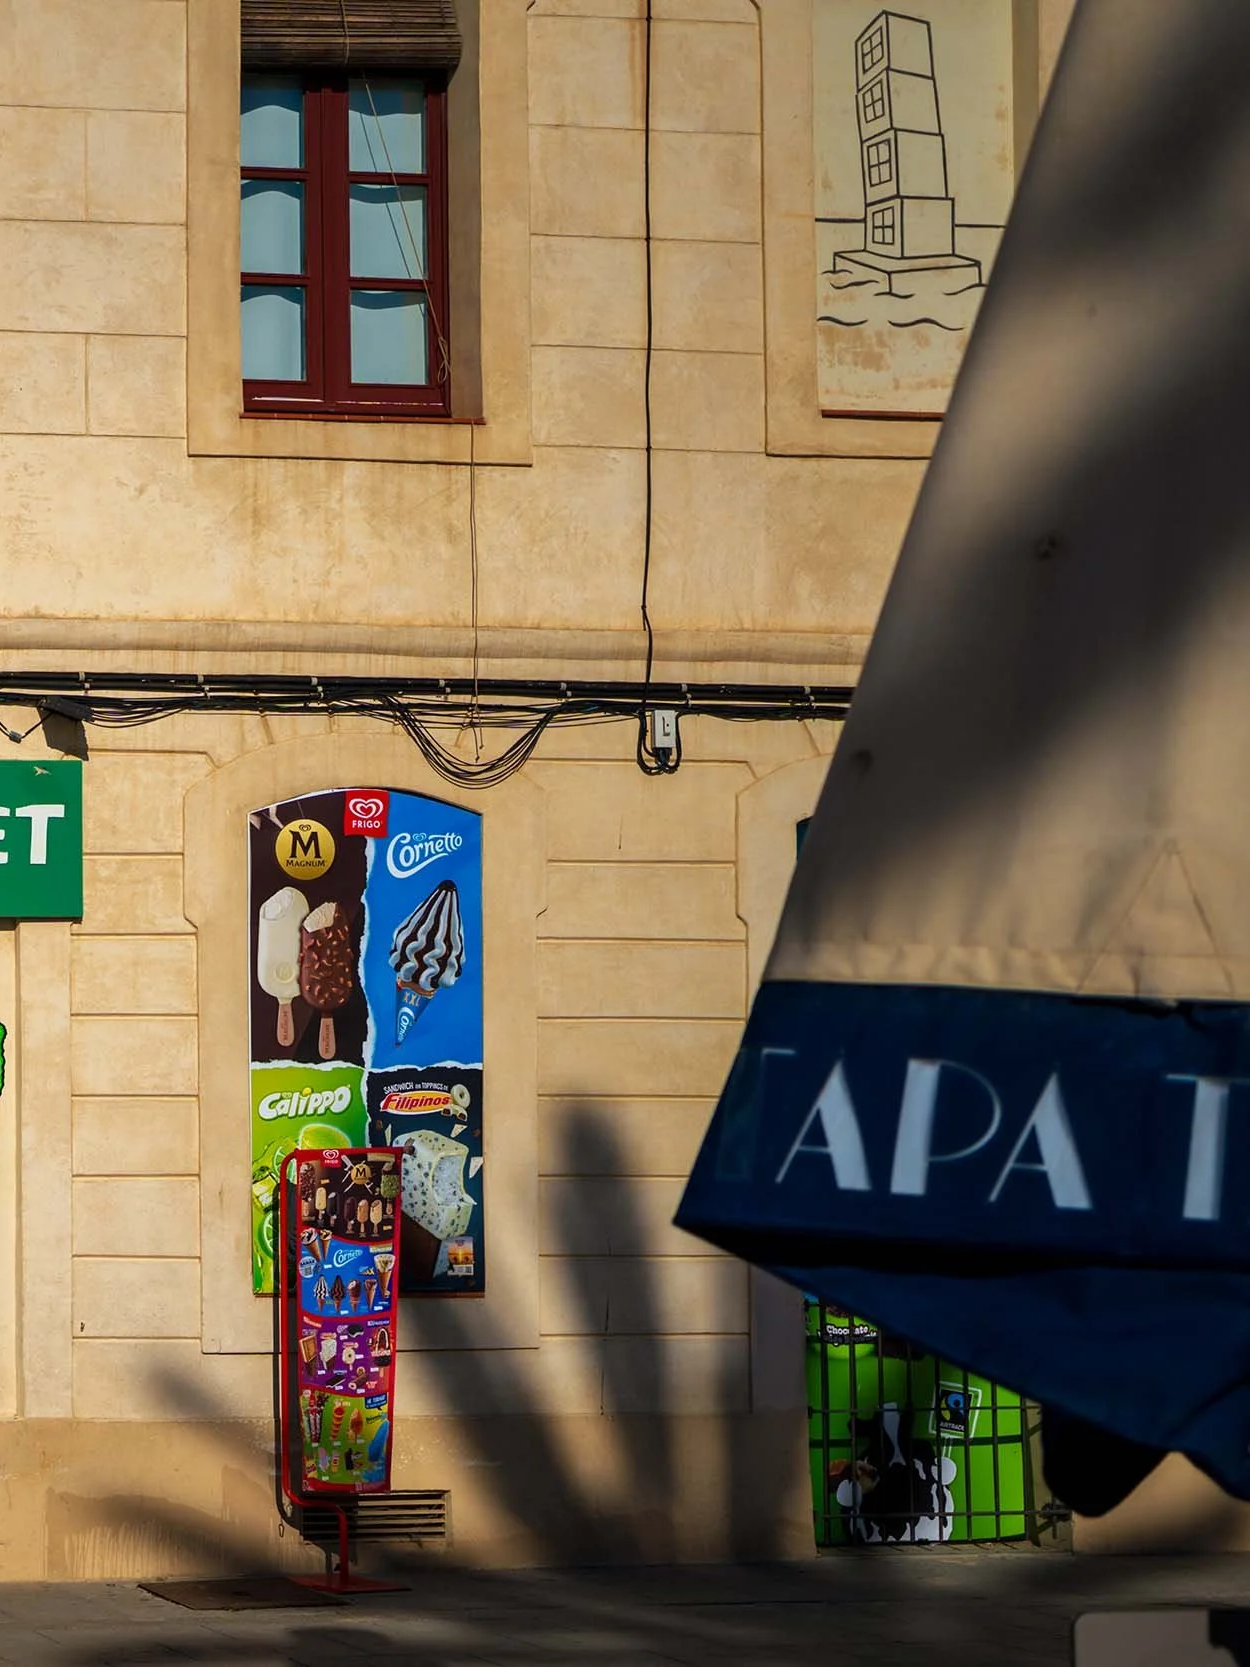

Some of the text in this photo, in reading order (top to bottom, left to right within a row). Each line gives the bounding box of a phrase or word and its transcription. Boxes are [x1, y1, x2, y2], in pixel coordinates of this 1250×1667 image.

[352, 819, 381, 829] FRIGO
[386, 832, 463, 879] Cornetto
[286, 859, 326, 868] MAGNUM
[383, 1082, 414, 1095] SANDWICH
[381, 1093, 451, 1111] Filipinos
